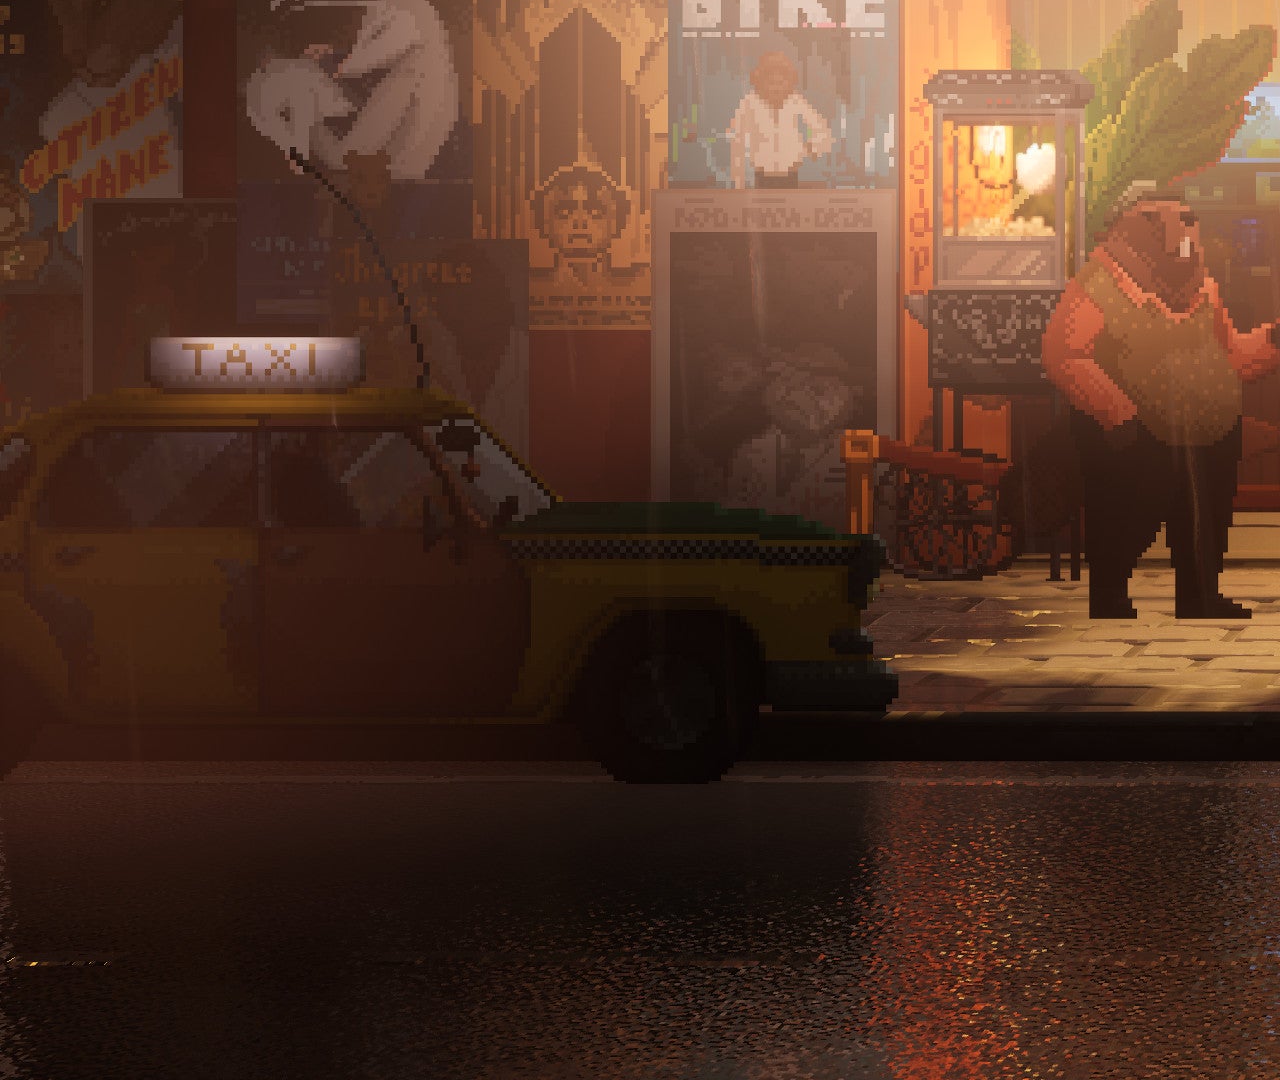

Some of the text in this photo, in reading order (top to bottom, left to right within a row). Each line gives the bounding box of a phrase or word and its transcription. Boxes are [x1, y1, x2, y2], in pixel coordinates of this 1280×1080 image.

[20, 57, 184, 194] CITIZEN
[57, 129, 174, 232] MANE
[181, 343, 317, 377] TAXI
